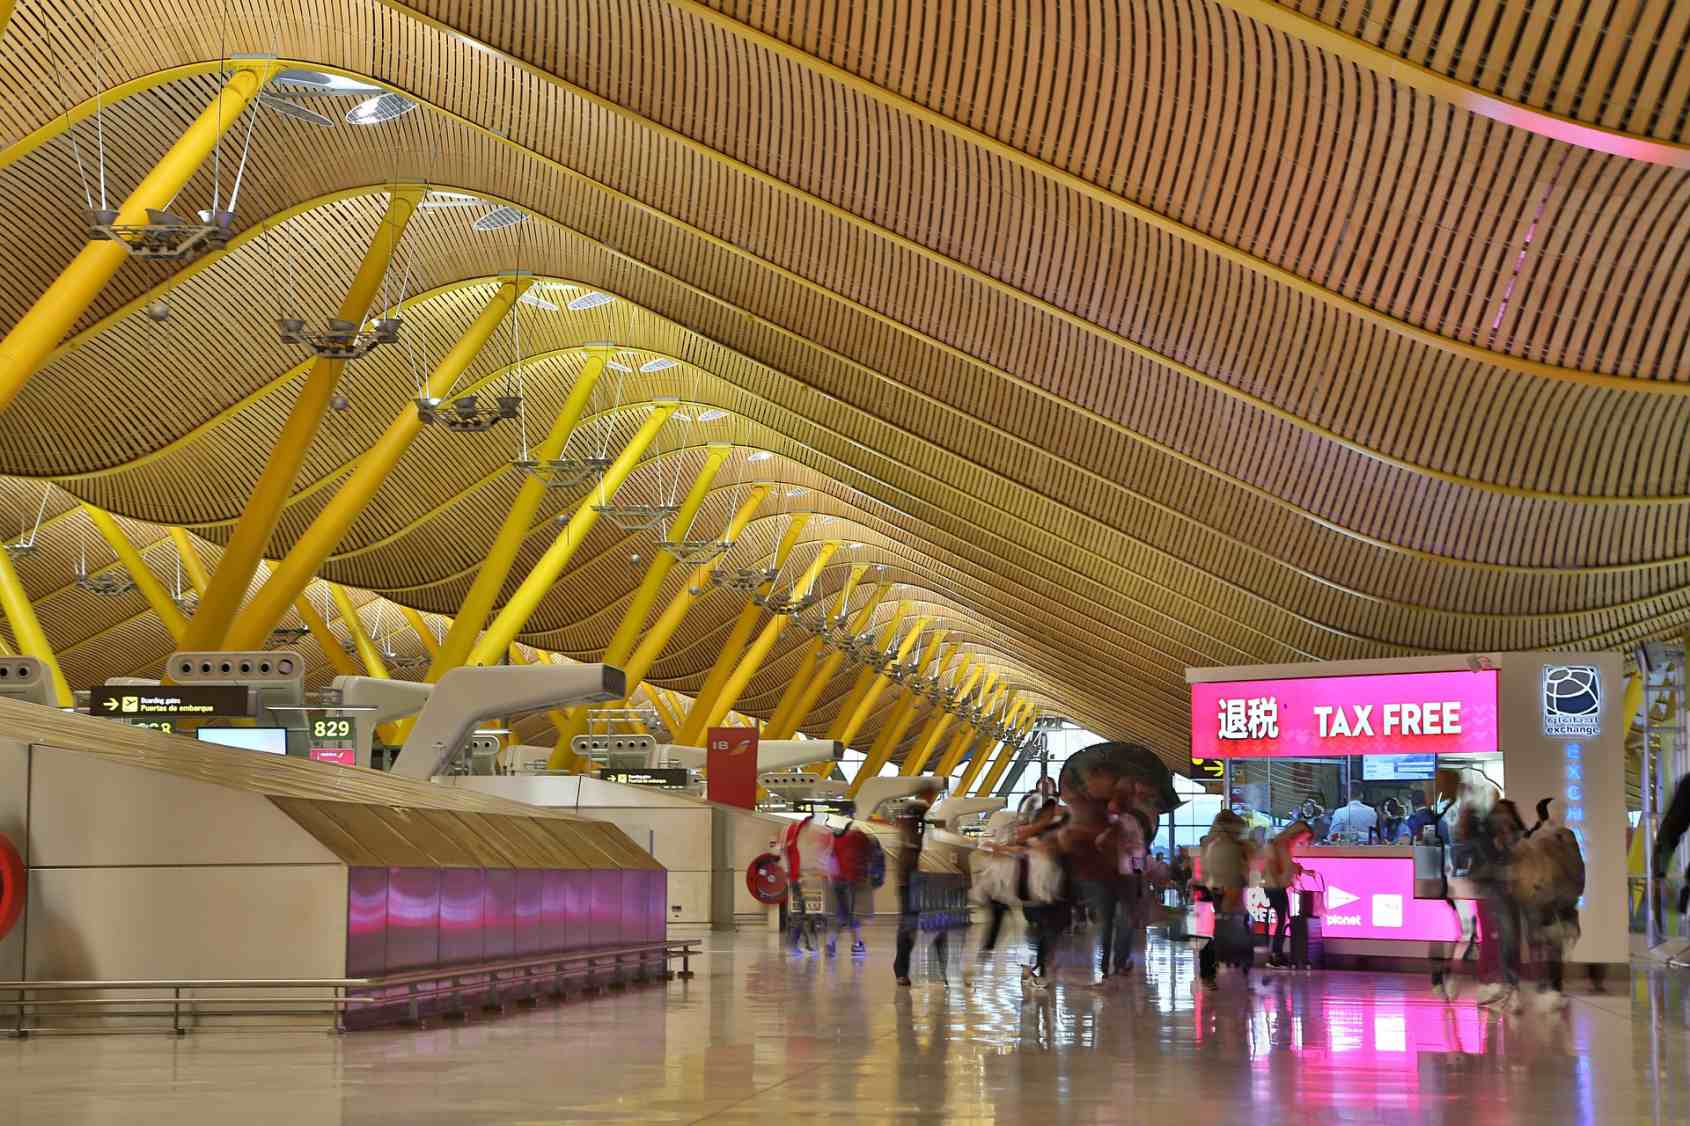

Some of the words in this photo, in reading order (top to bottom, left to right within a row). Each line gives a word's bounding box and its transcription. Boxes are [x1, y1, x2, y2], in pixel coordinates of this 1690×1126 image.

[314, 721, 350, 737] 829
[1217, 697, 1280, 740] 退税
[1314, 704, 1374, 737] TAX
[1383, 702, 1462, 736] FREE
[1326, 914, 1361, 927] planet
